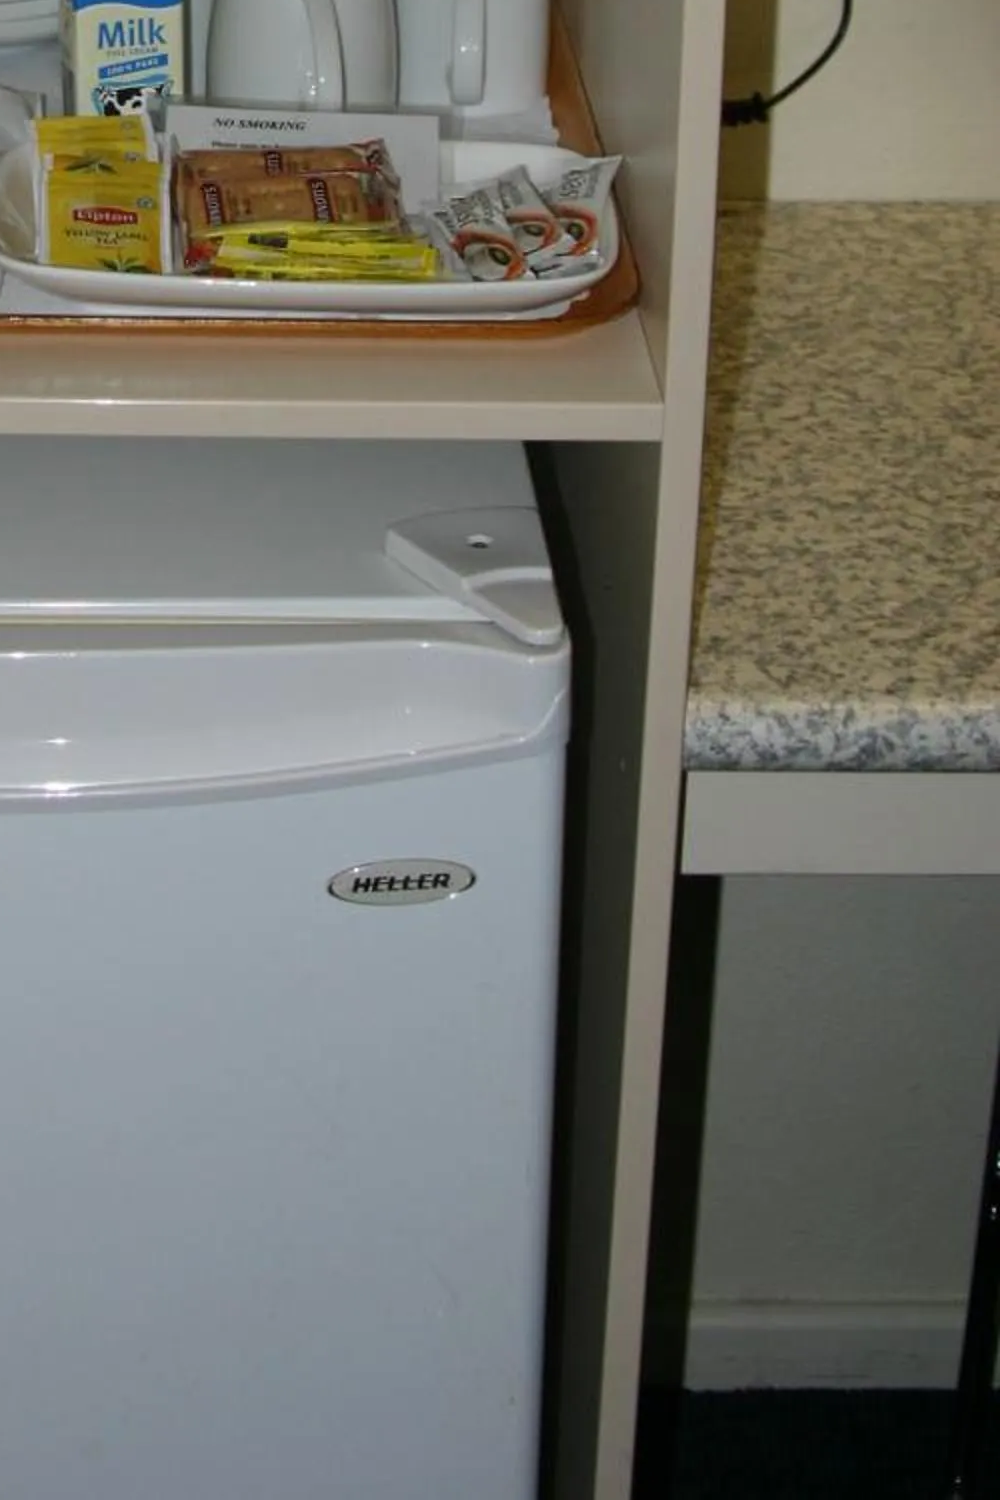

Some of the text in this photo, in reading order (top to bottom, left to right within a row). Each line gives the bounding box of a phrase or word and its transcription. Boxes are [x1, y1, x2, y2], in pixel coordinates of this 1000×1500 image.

[98, 18, 168, 49] Milk
[213, 117, 307, 131] NO SMOKING
[77, 210, 134, 222] Lipton
[352, 873, 451, 894] HELLER
